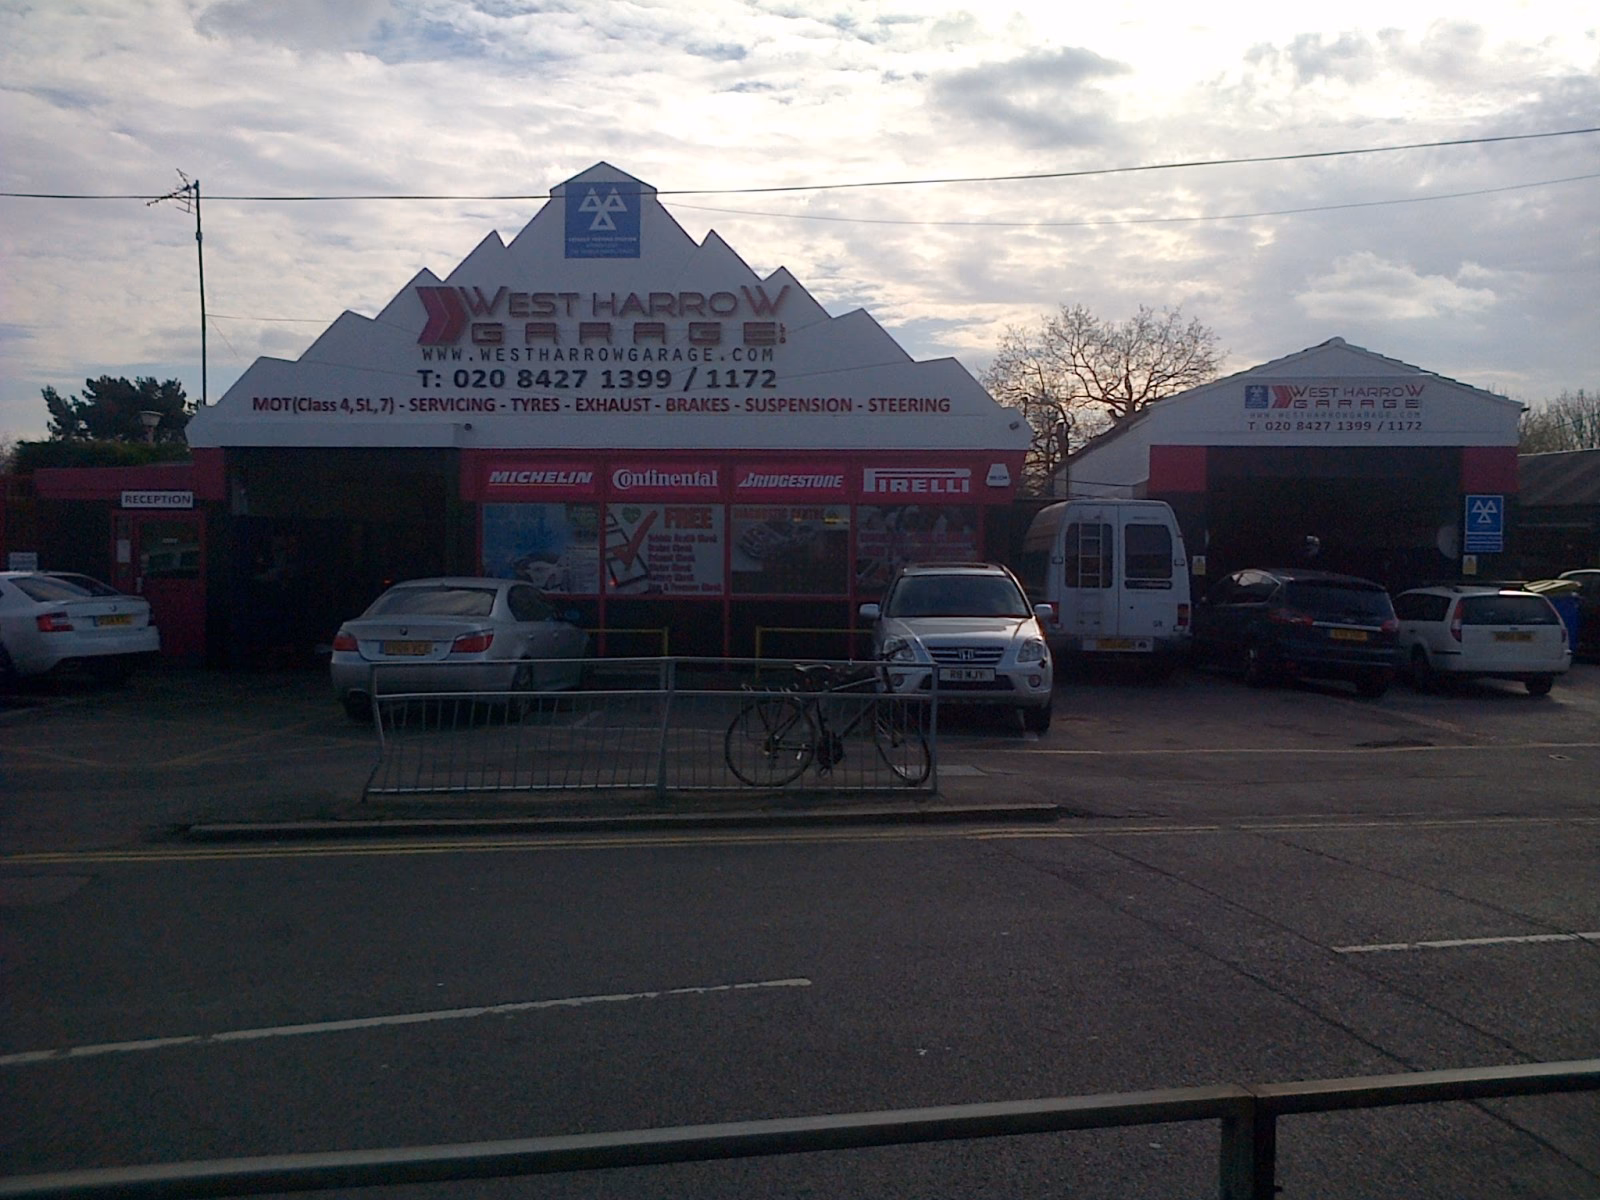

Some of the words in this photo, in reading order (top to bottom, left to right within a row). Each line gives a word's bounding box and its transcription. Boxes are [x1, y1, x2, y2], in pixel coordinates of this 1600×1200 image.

[459, 285, 580, 318] WEST
[591, 285, 791, 318] HARROW
[471, 321, 777, 346] GARAGE
[421, 347, 775, 362] WWW.WESTHARROWGARAGE.COM
[417, 369, 442, 389] T:
[453, 369, 506, 389] 020
[516, 369, 589, 389] 8427
[600, 369, 672, 389] 1399
[682, 367, 698, 392] /
[706, 369, 777, 389] 1172
[1288, 384, 1339, 398] WEST
[1343, 384, 1425, 398] HARROW
[252, 397, 337, 414] MOT(Class
[408, 397, 496, 412] SERVICING
[510, 397, 560, 412] TYRES
[574, 397, 651, 412] EXHAUST
[665, 397, 730, 412] BRAKES
[745, 397, 852, 412] SUSPENSION
[868, 397, 951, 412] STEERING
[1293, 399, 1420, 409] GARAGE
[1265, 421, 1291, 431] 020
[1296, 421, 1331, 431] 8427
[1337, 421, 1372, 431] 1399
[1388, 421, 1423, 431] 1172
[488, 471, 593, 484] MICHELIN
[612, 469, 719, 490] Continental
[738, 472, 844, 488] BRIDGESTONE
[863, 468, 971, 493] PIRELLI
[124, 494, 191, 505] RECEPTION
[664, 507, 713, 529] FREE
